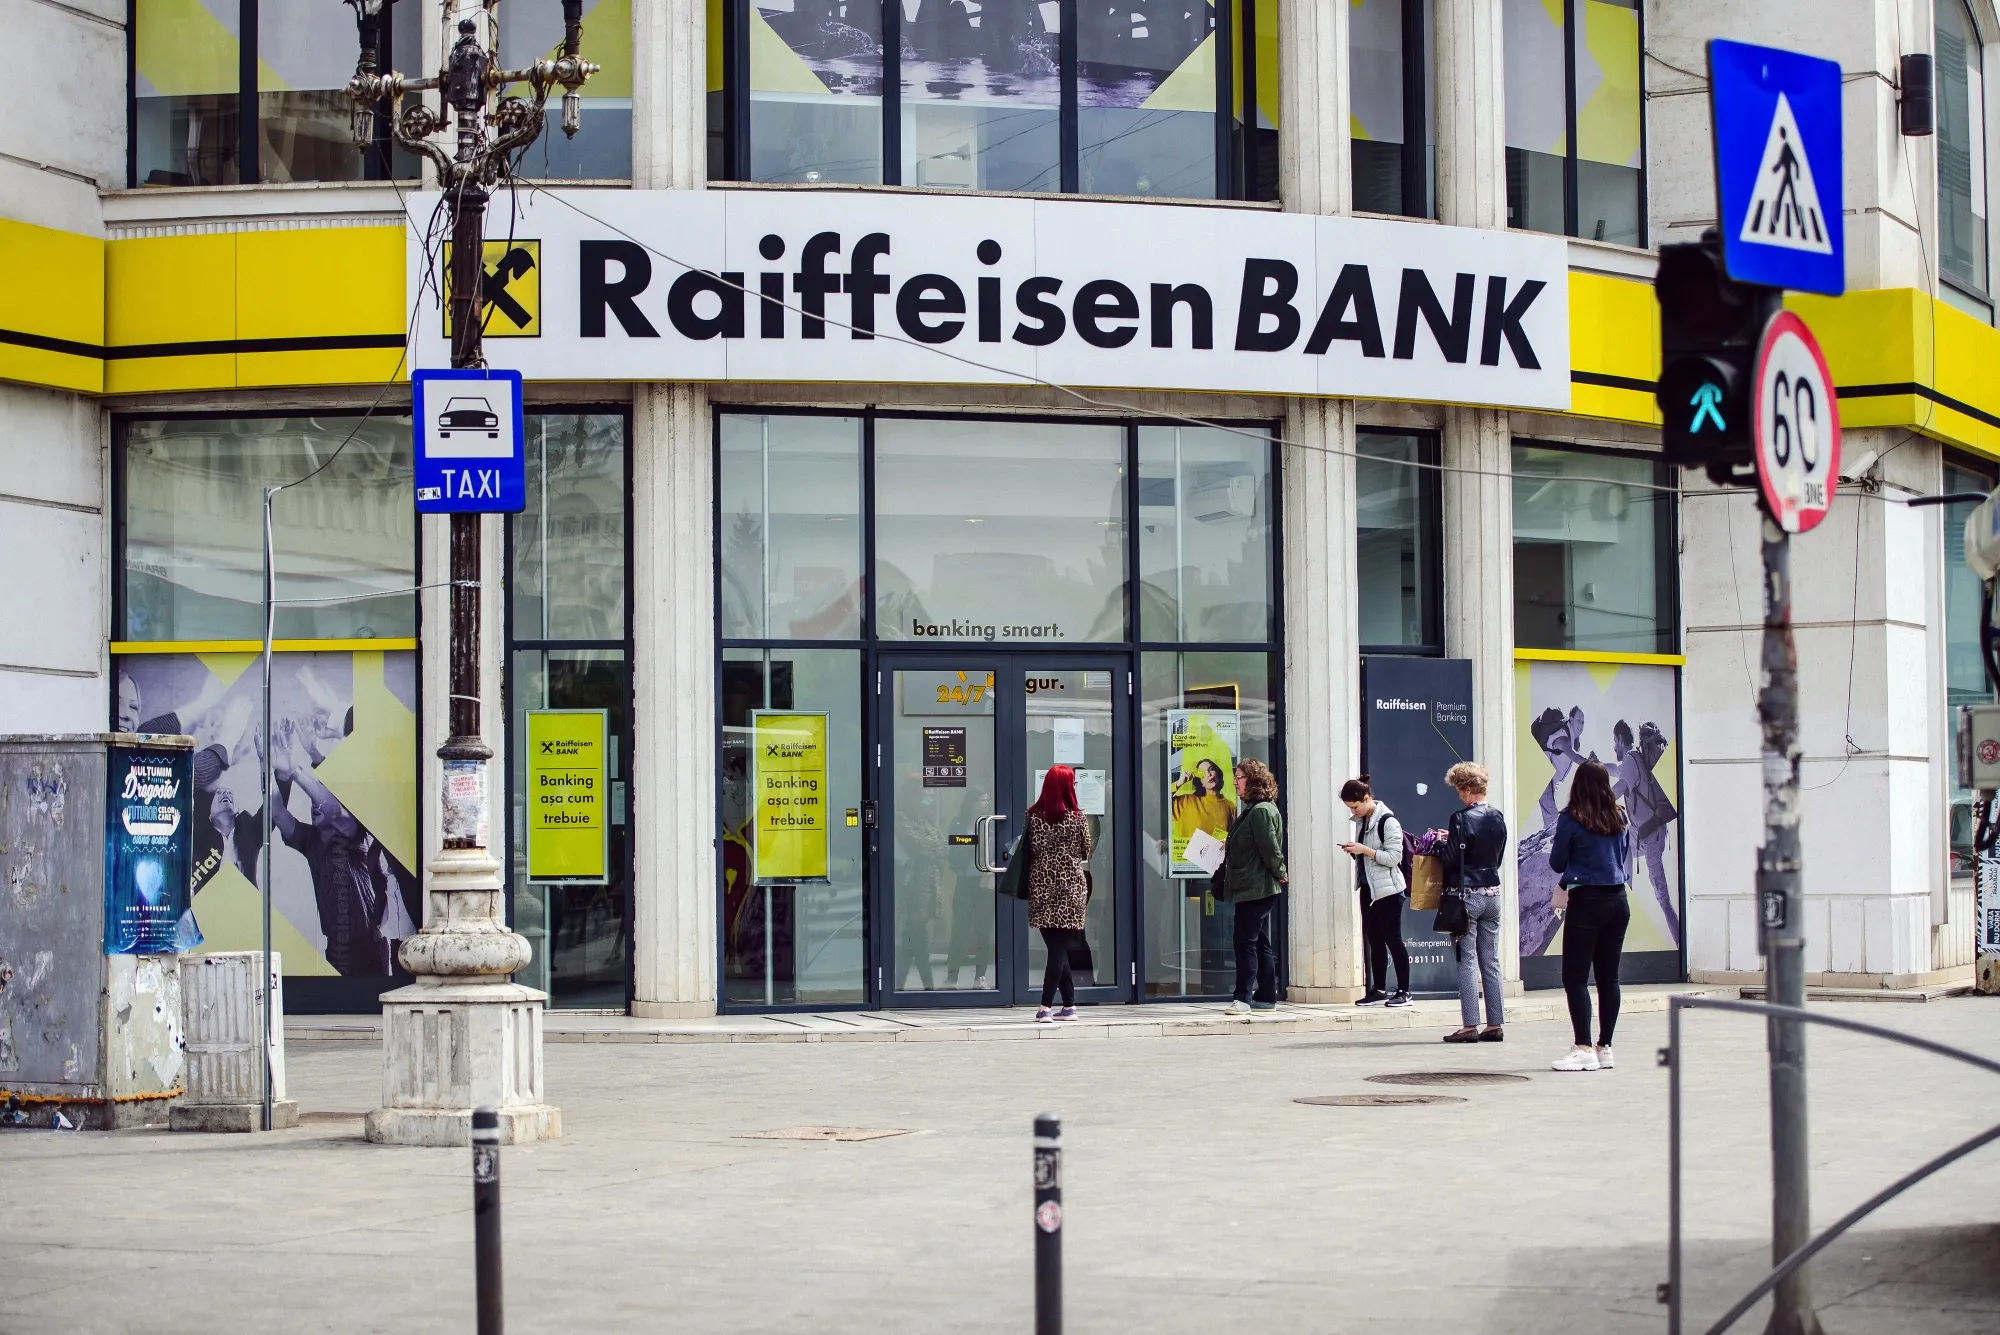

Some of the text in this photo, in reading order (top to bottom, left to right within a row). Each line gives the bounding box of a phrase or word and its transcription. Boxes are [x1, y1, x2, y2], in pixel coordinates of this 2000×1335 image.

[1773, 369, 1815, 473] 60
[441, 469, 500, 499] TAXI
[913, 618, 1065, 641] banking smart.
[936, 684, 987, 705] 24/7
[1376, 698, 1427, 710] Raiffeisen
[1436, 701, 1467, 711] Premium
[1436, 712, 1467, 725] Banking
[540, 773, 594, 789] Banking
[766, 775, 818, 791] Banking
[540, 795, 594, 806] așa cum
[767, 796, 818, 808] așa cum
[543, 811, 590, 823] trebuie
[770, 813, 815, 825] trebuie
[1993, 932, 2000, 944] NU
[1414, 955, 1428, 964] 811
[1431, 955, 1444, 963] 111
